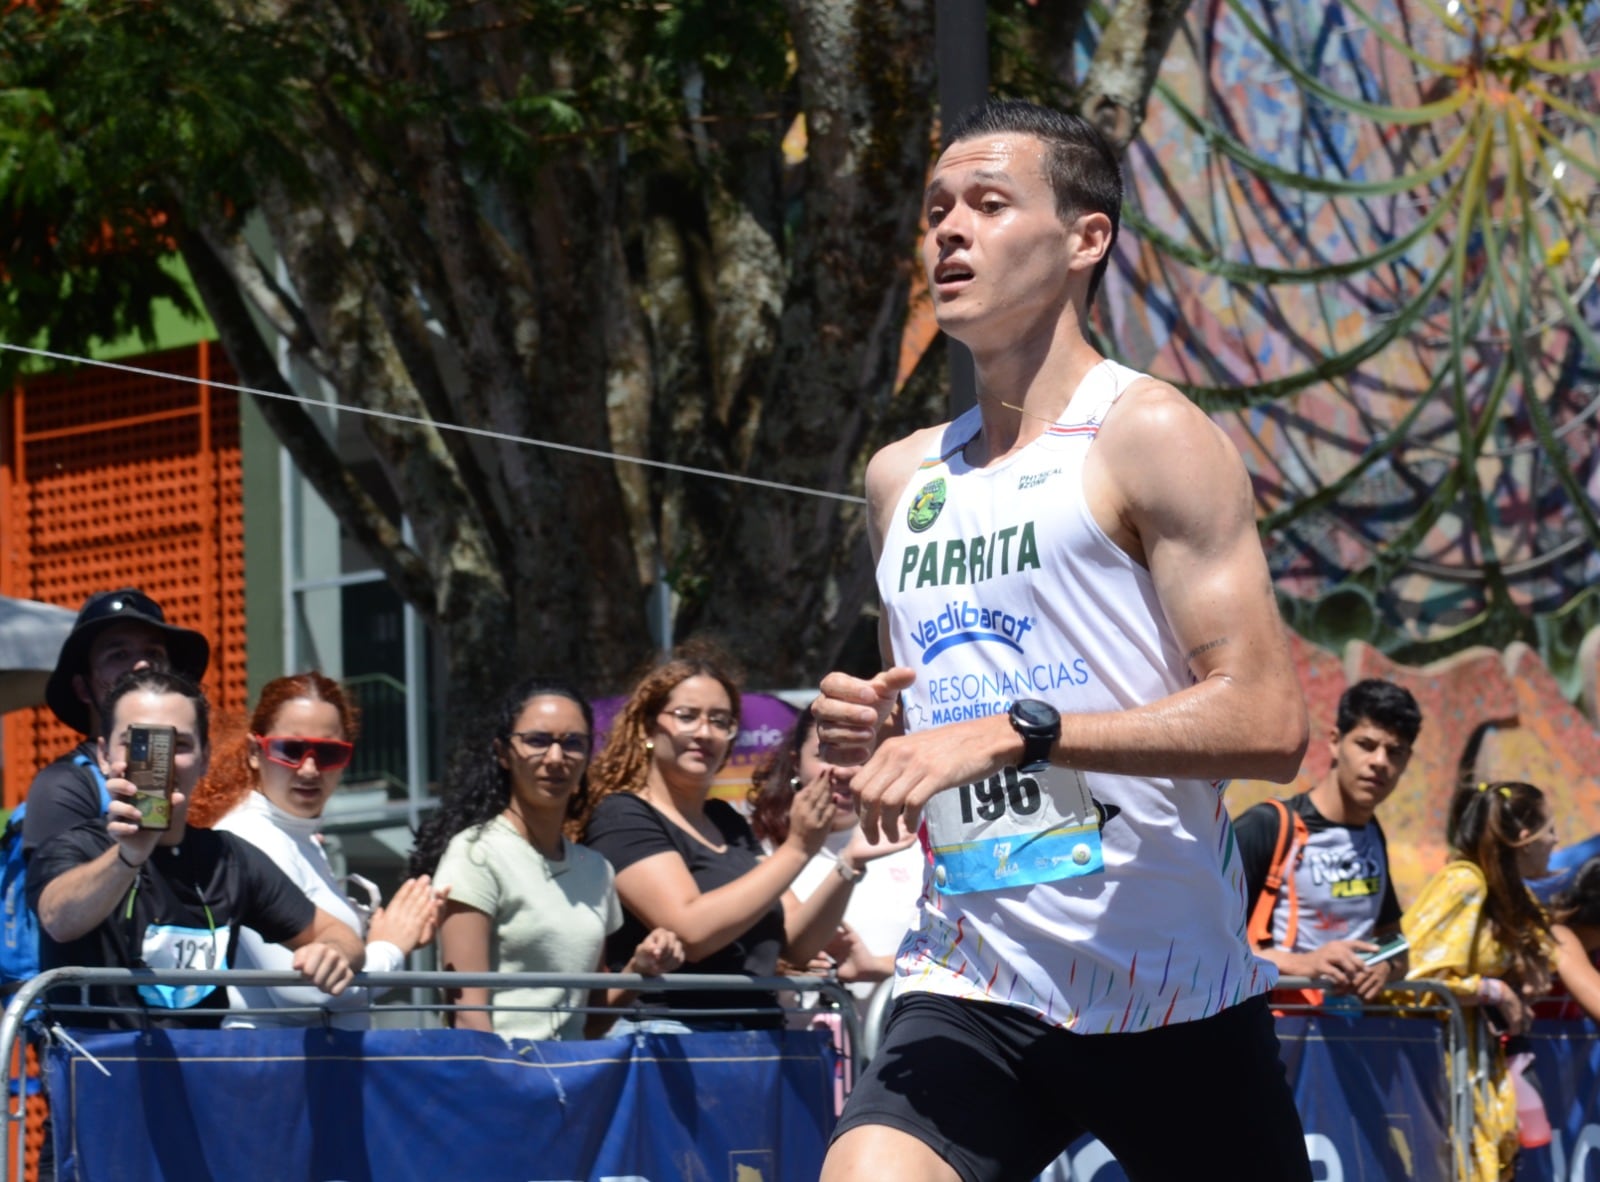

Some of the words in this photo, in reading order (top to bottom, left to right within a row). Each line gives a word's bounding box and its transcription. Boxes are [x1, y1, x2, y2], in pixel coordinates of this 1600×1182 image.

[898, 521, 1041, 593] PARRITA
[929, 658, 1089, 705] RESONANCIAS
[931, 700, 1012, 725] MAGNÉTICA
[958, 765, 1042, 825] 196
